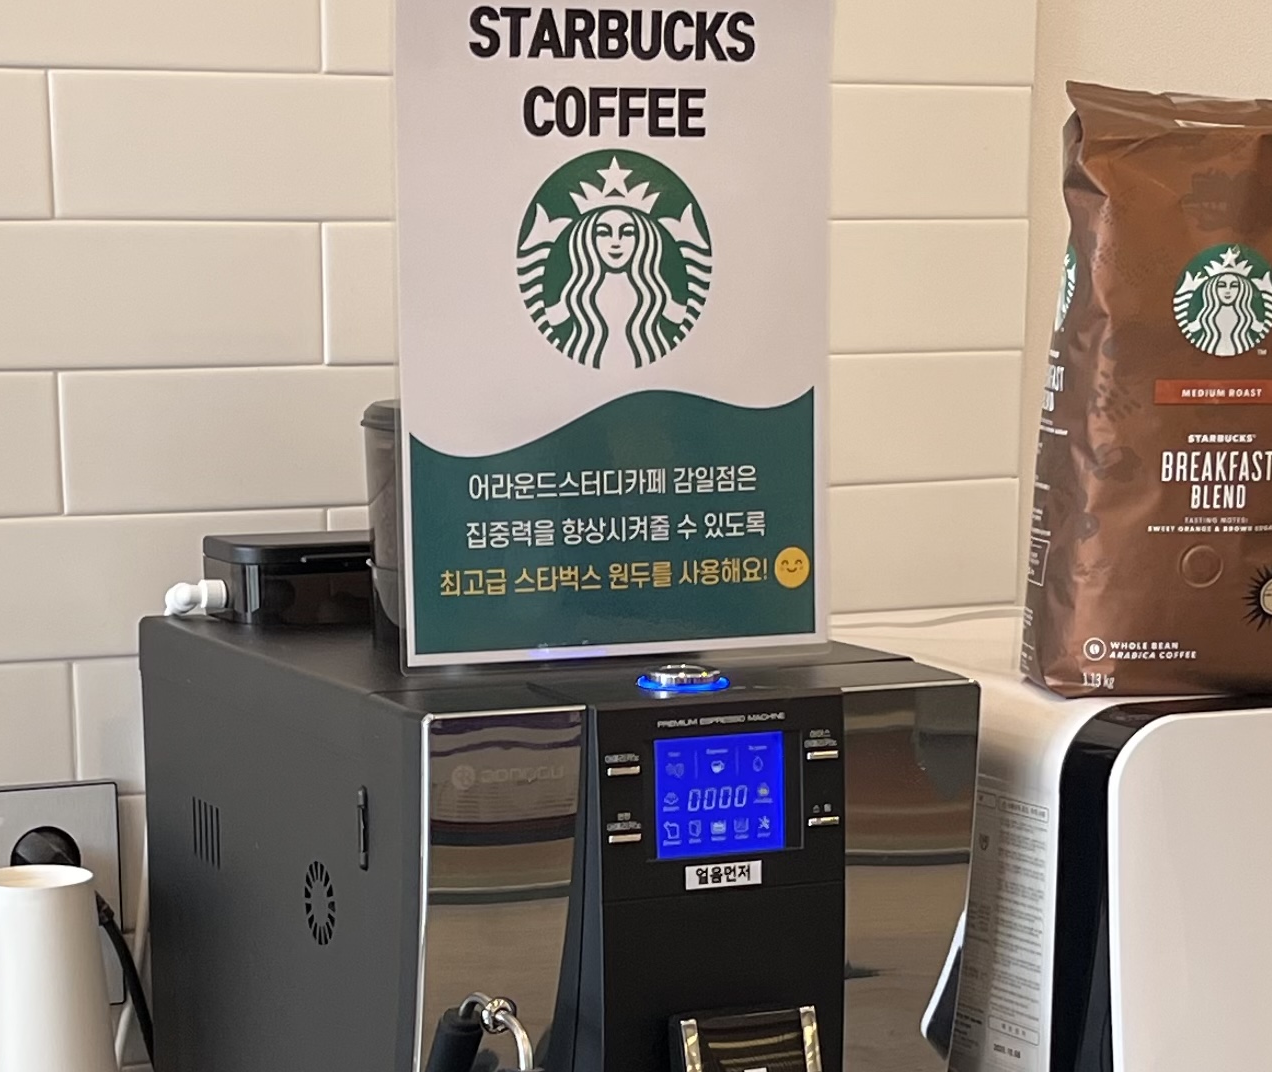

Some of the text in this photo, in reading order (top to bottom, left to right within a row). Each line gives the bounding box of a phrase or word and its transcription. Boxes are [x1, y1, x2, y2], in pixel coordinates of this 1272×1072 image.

[469, 6, 755, 62] STARBUCKS
[523, 86, 706, 137] COFFEE
[1181, 388, 1262, 398] MEDIUM ROAST
[469, 465, 757, 500] 어라운드스터디카페 감일점은
[1190, 484, 1246, 509] BLEND
[466, 511, 766, 549] 집중력을 향상시켜줄 수 있도록
[440, 556, 768, 596] 최고급 스타벅스 원두를 사용해요!
[1109, 651, 1197, 659] ARABICA COFFEE
[1110, 641, 1179, 650] WHOLE BEAN
[657, 718, 698, 728] PREMIUM
[696, 864, 751, 885] 얼음먼저
